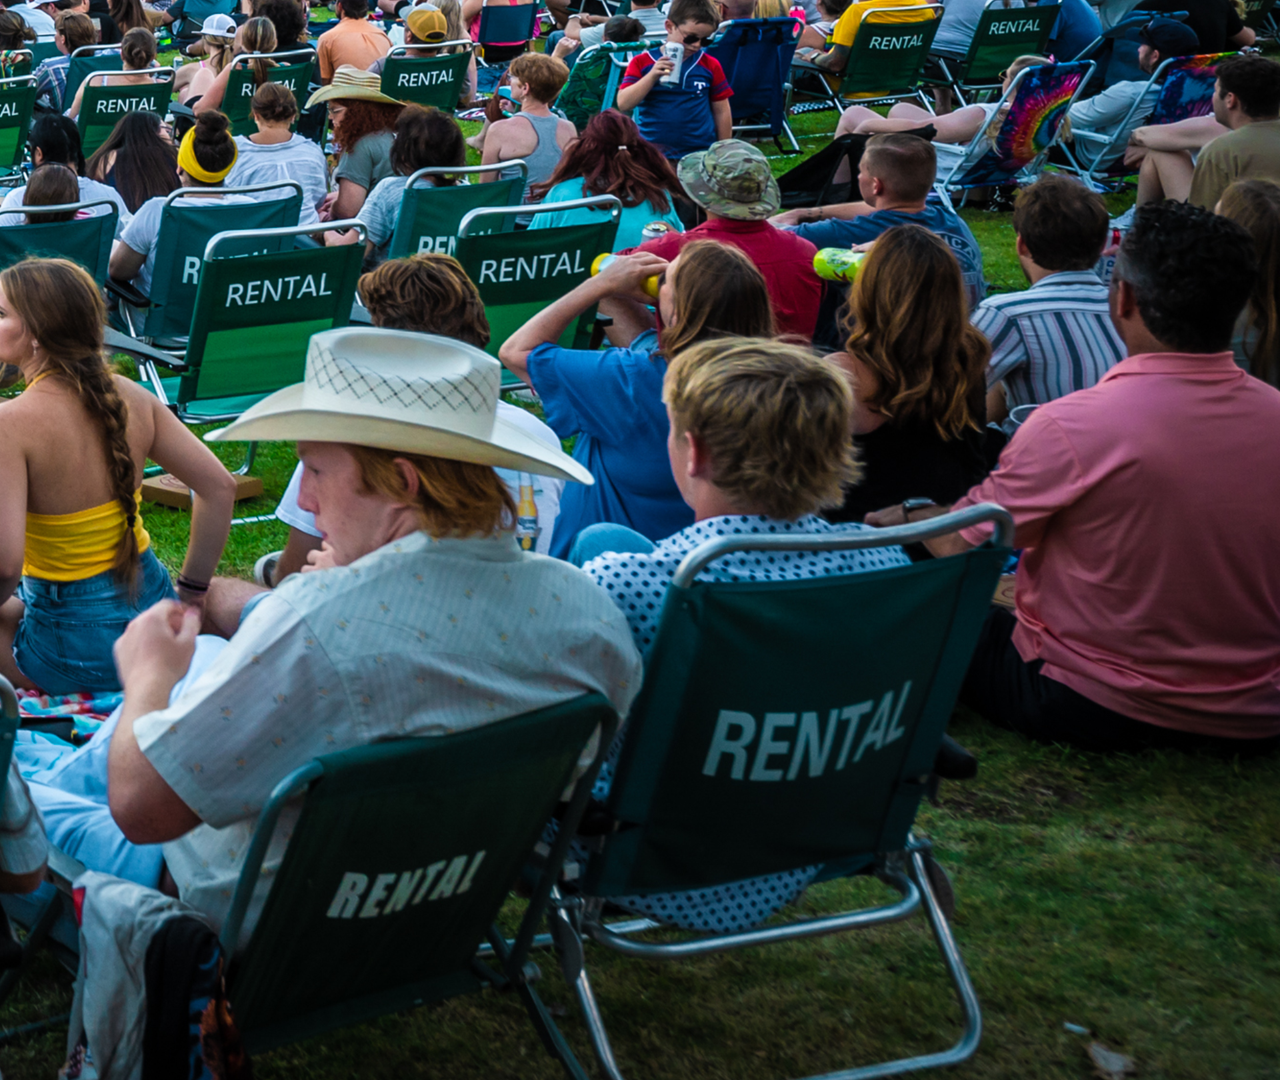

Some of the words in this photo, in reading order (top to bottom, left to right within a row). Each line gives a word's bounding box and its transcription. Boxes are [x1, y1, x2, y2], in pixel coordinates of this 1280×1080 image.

[989, 18, 1041, 36] RENTAL
[868, 33, 925, 50] RENTAL
[397, 68, 455, 87] RENTAL
[96, 97, 157, 114] RENTAL
[478, 249, 586, 284] RENTAL
[225, 272, 332, 308] RENTAL
[701, 679, 913, 782] RENTAL
[326, 850, 486, 919] RENTAL
